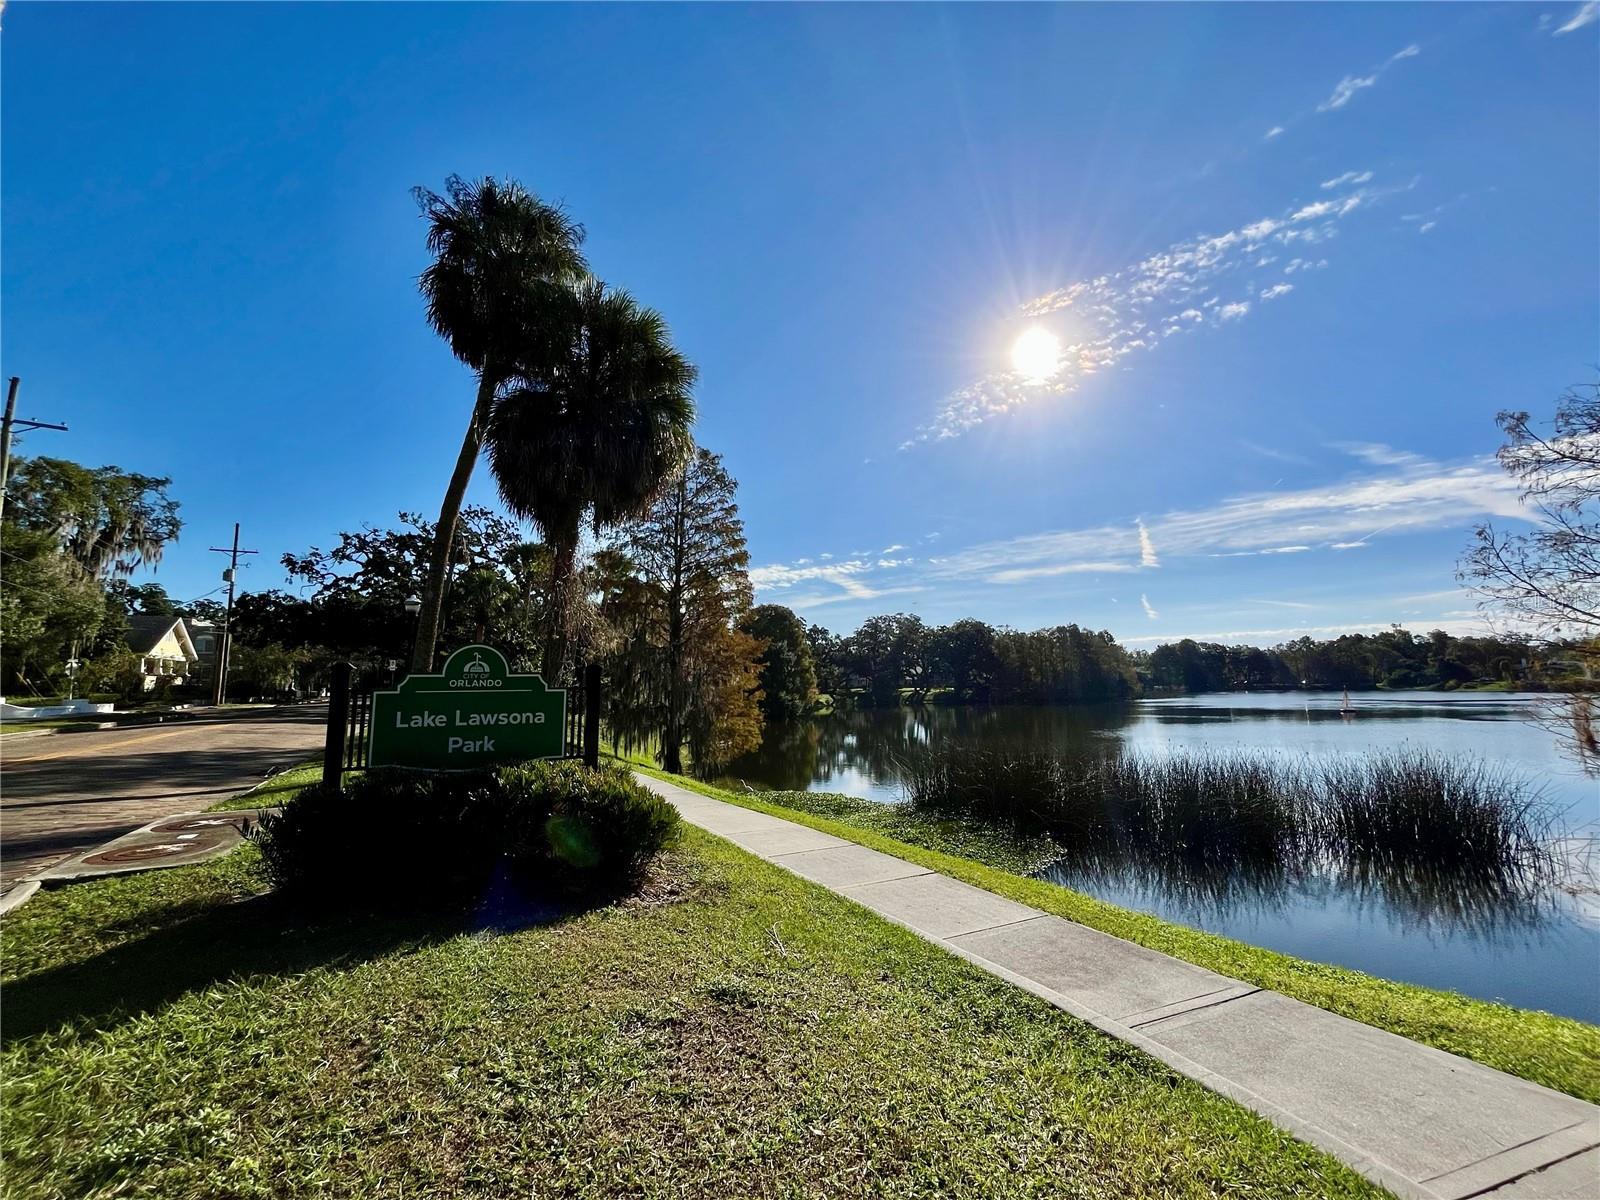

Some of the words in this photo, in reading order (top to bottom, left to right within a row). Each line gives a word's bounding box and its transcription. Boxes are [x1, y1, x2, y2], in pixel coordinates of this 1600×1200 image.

[396, 710, 447, 728] Lake
[455, 709, 545, 726] Lawsona
[448, 736, 496, 753] Park
